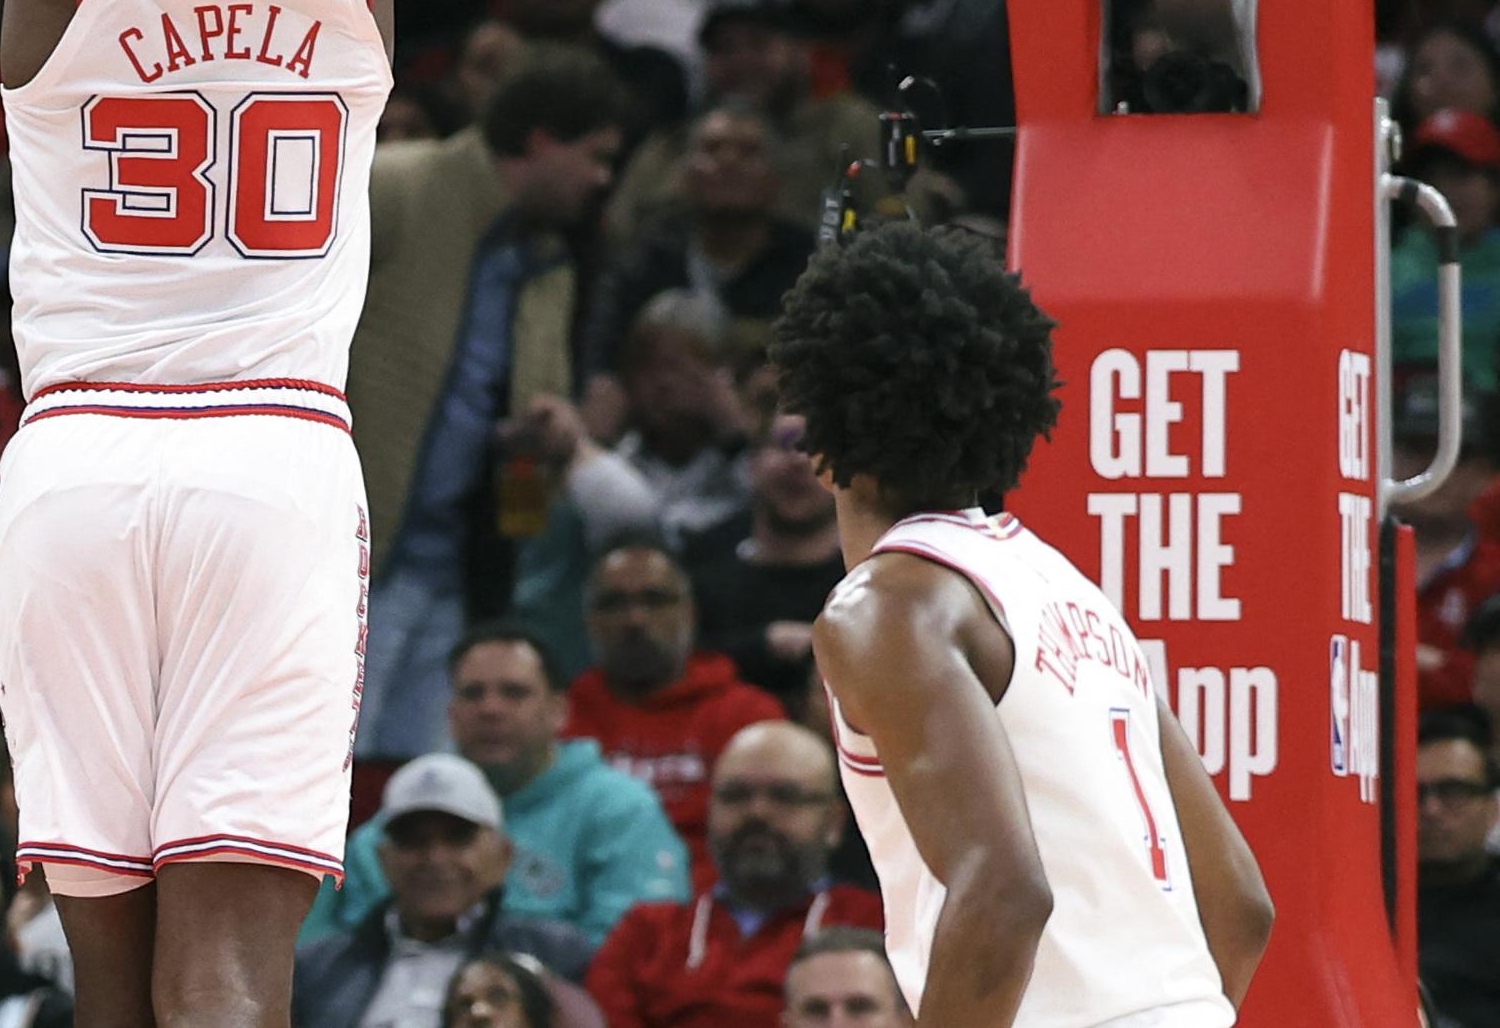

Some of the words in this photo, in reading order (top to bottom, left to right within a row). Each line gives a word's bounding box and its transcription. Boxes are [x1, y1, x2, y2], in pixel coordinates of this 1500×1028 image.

[118, 2, 322, 84] CAPELA
[80, 90, 349, 260] 30
[1089, 348, 1240, 480] GET
[1338, 348, 1371, 480] GET
[1087, 492, 1242, 621] THE
[1338, 492, 1373, 624] THE
[1108, 707, 1173, 892] 1
